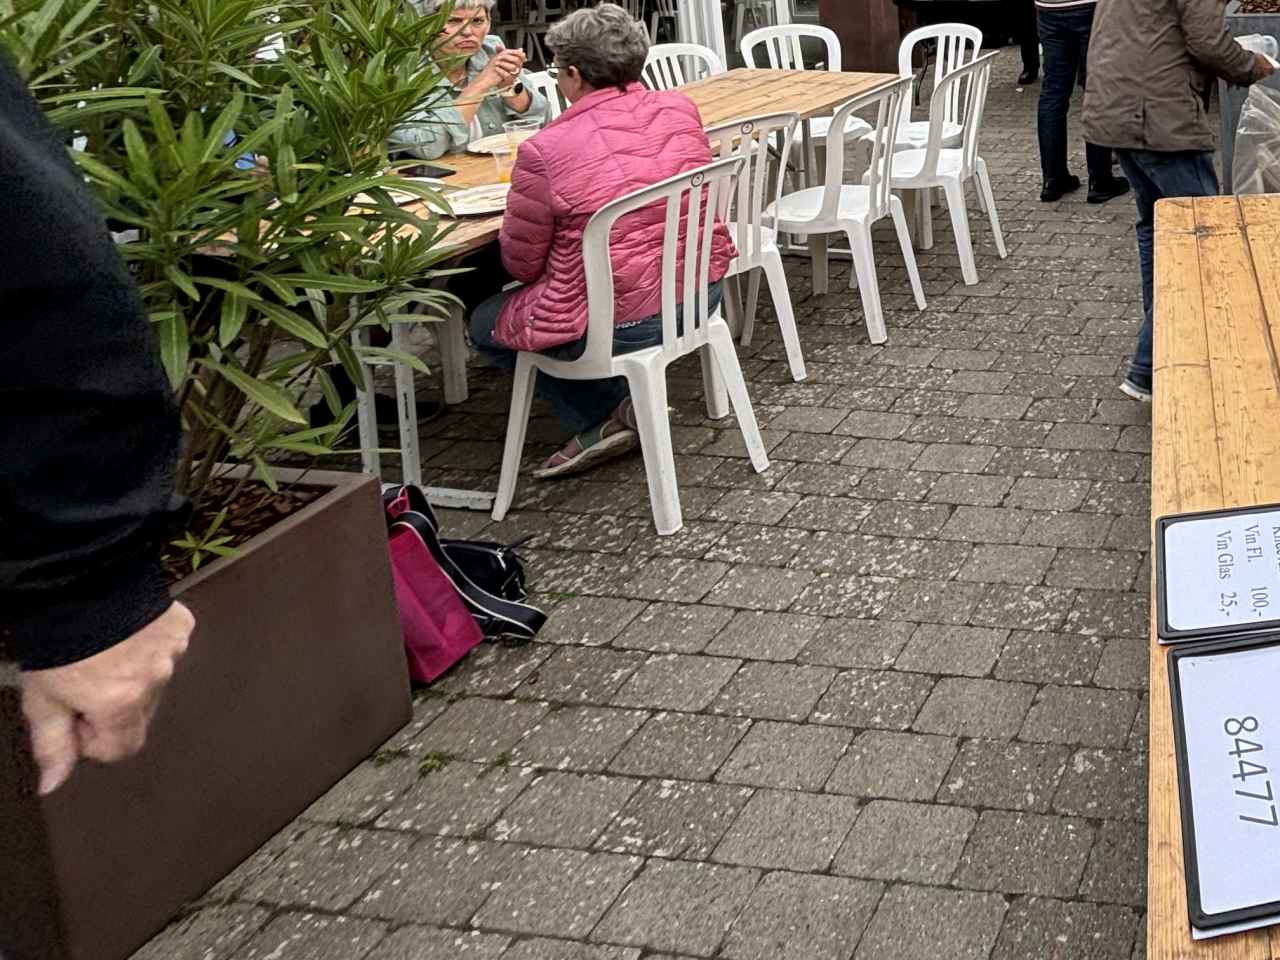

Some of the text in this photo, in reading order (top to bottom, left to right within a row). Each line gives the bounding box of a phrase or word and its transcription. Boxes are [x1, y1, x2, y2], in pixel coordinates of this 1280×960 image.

[1215, 529, 1238, 618] Vin Glas 25,-
[1243, 524, 1269, 618] Vin Fl. 100,-
[1223, 715, 1280, 828] 84477
